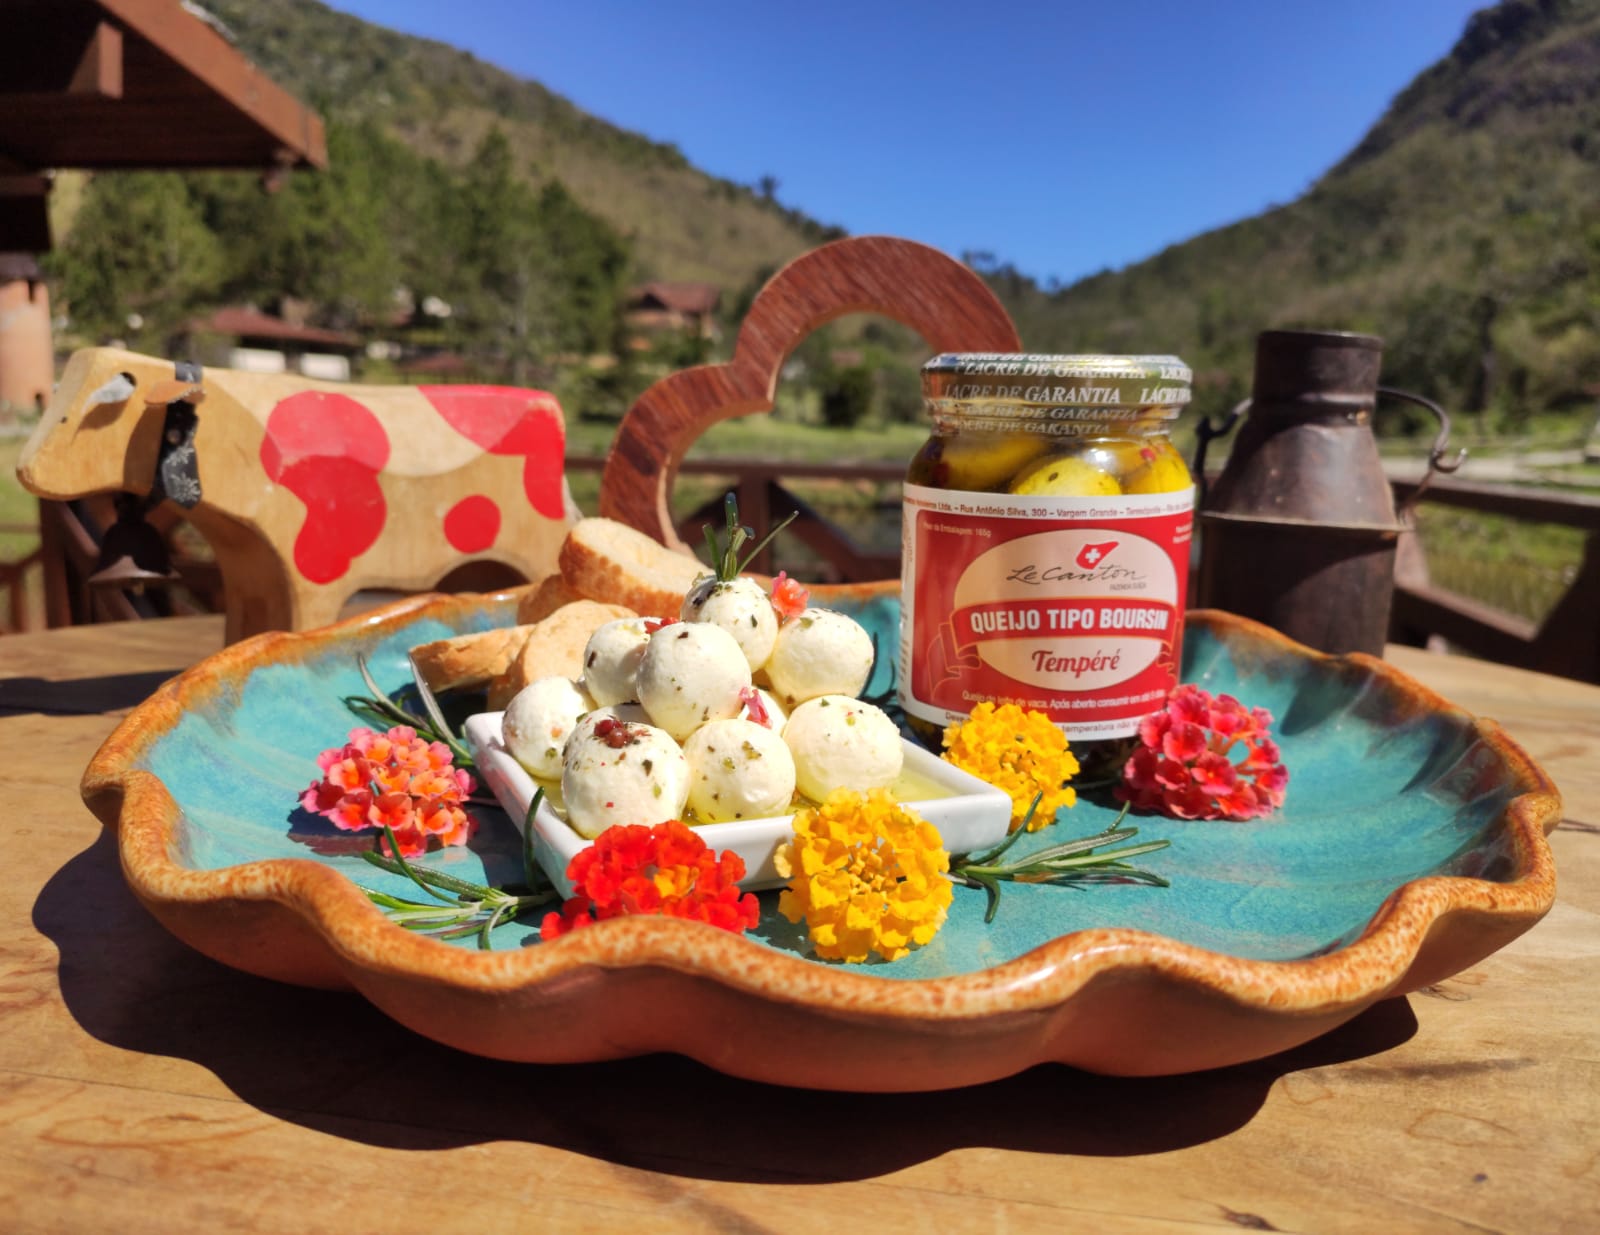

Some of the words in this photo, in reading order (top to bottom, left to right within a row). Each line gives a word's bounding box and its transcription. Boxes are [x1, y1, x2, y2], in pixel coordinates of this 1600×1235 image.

[1022, 364, 1050, 376] DE
[995, 386, 1022, 399] DE
[1024, 387, 1121, 404] GARANTIA
[960, 504, 974, 513] Rua
[975, 506, 1005, 516] Antônio
[1031, 508, 1047, 516] 300
[1057, 508, 1087, 518] Vargem
[1089, 508, 1118, 517] Grande
[1006, 565, 1041, 585] Le
[1042, 565, 1147, 583] Canton
[970, 610, 1041, 634] QUEIJO
[1047, 608, 1095, 630] TIPO
[1099, 608, 1169, 630] BOURSIN
[1031, 648, 1121, 679] Tempéré
[1050, 698, 1070, 709] Após
[1071, 699, 1097, 708] aberto
[1062, 724, 1114, 733] temperatura
